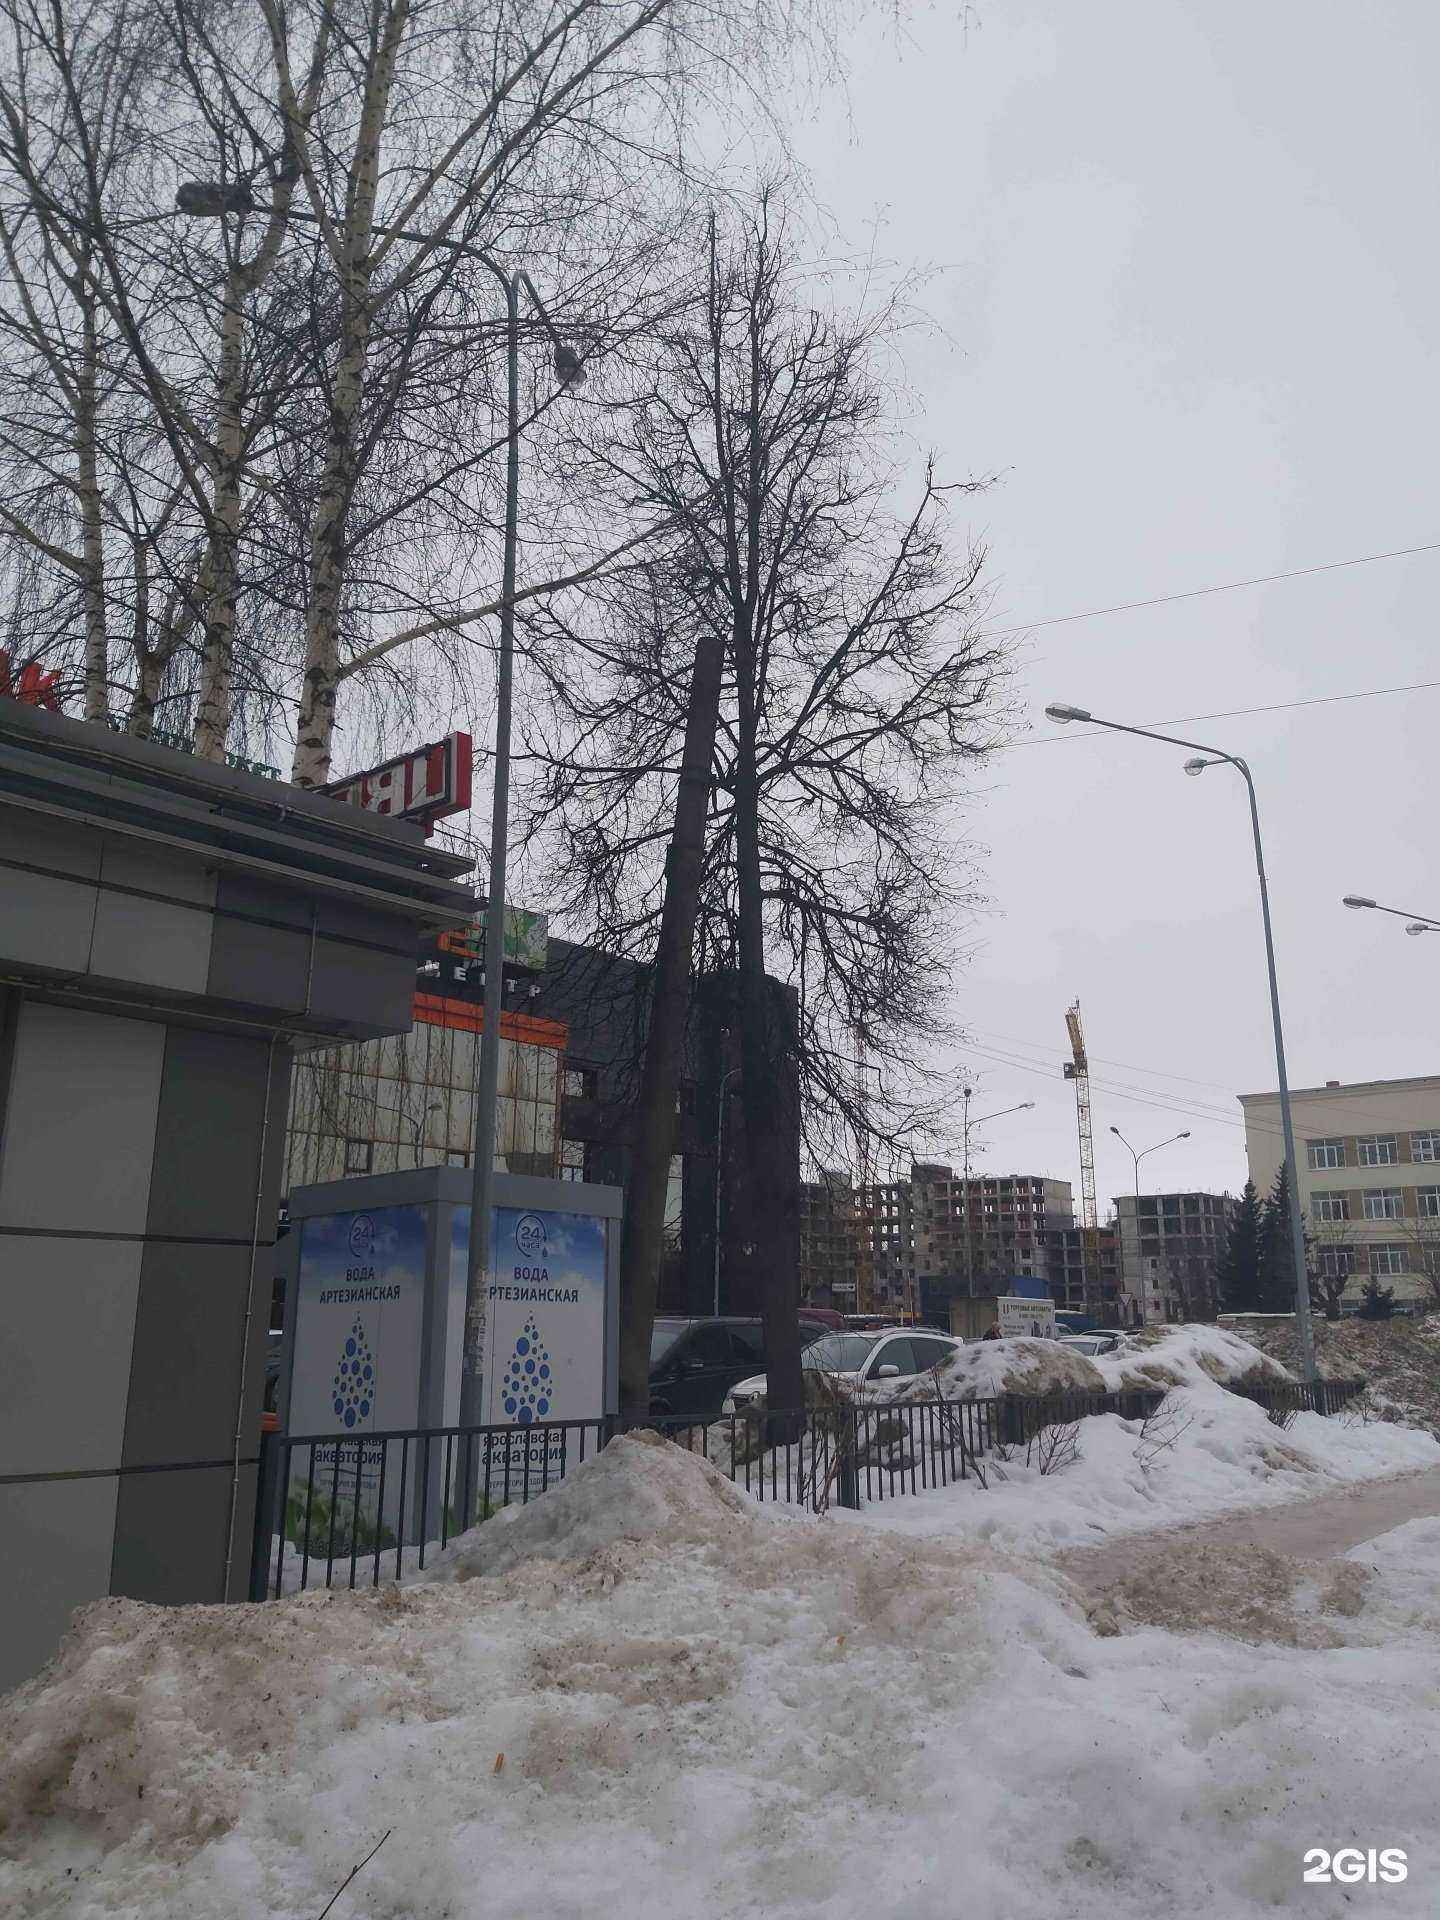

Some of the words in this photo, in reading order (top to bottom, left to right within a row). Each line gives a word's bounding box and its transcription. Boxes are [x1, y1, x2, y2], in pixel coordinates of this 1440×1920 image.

[352, 1226, 370, 1241] 24
[520, 1226, 541, 1240] 24
[345, 1266, 376, 1282] ВОДА
[514, 1267, 549, 1282] ВОДА
[320, 1285, 401, 1304] АРТЕЗИАНСКАЯ
[488, 1286, 579, 1303] РТЕЗИАНСКАЯ
